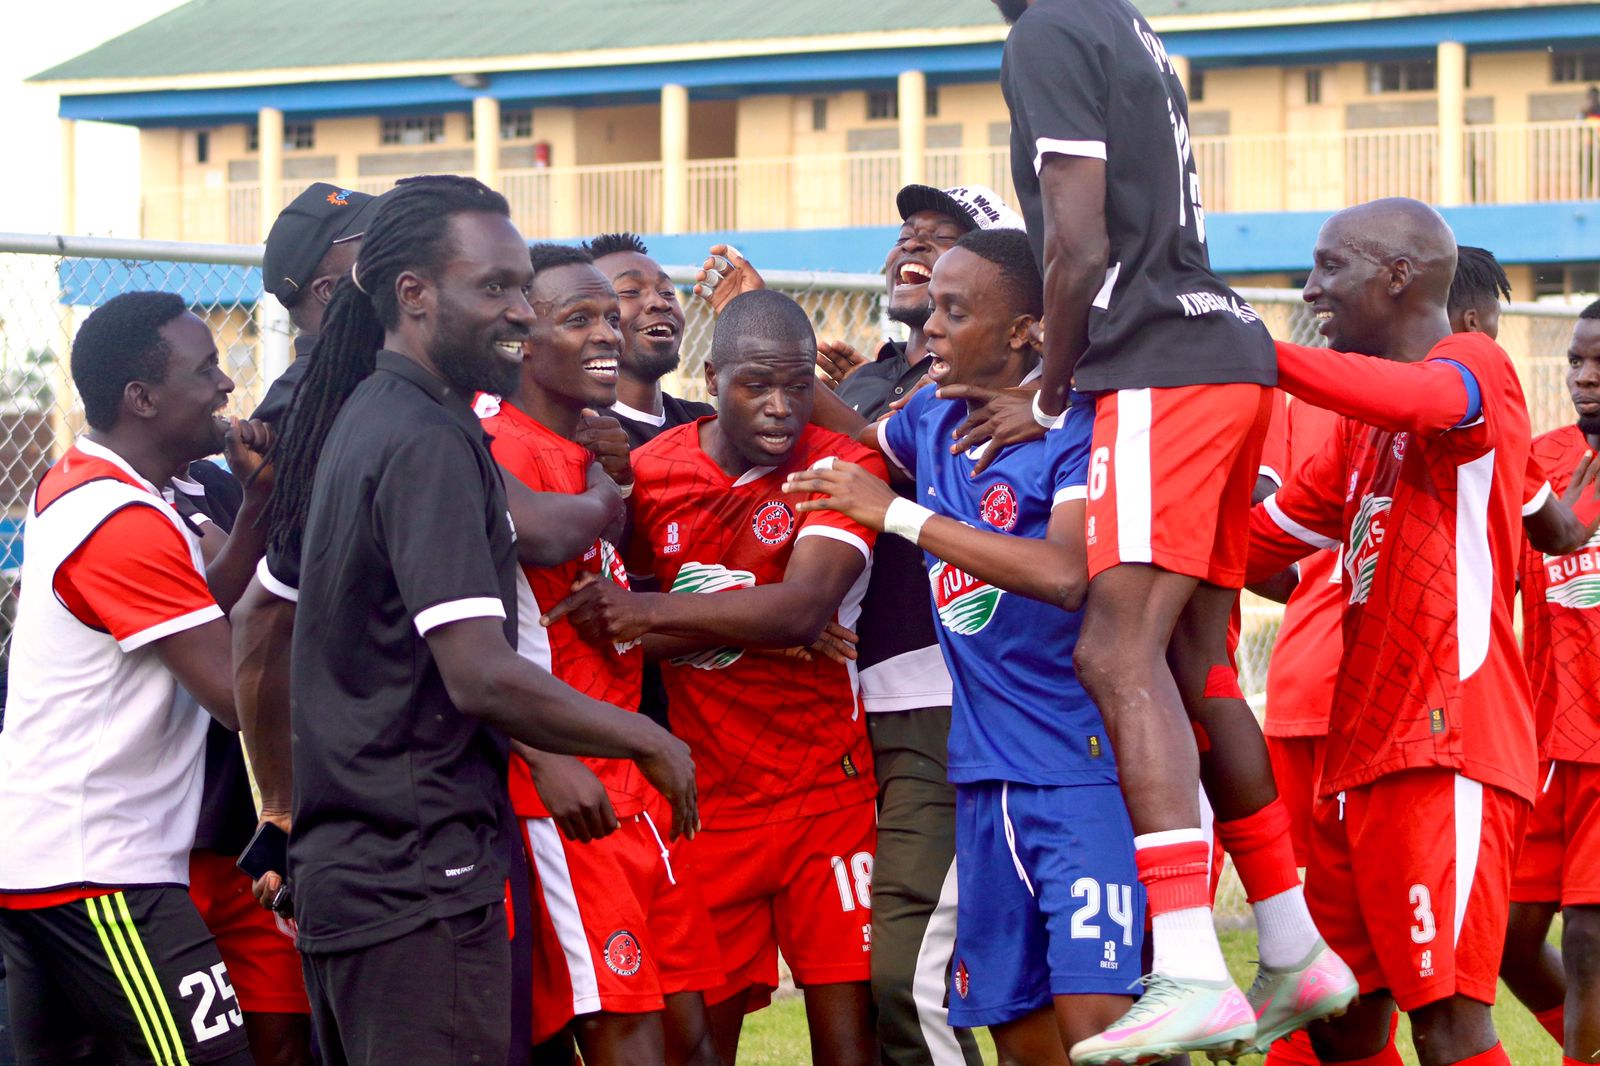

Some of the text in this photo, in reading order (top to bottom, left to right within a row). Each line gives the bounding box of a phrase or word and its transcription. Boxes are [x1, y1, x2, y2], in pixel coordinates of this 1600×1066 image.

[973, 195, 1000, 222] Walk
[1089, 446, 1110, 501] 6
[583, 547, 597, 561] BEEST
[663, 544, 681, 554] BEEST
[943, 568, 980, 600] RUB
[830, 851, 874, 912] 18
[1070, 877, 1133, 946] 24
[1409, 883, 1436, 944] 3
[1100, 960, 1118, 970] BEEST
[178, 961, 244, 1043] 25
